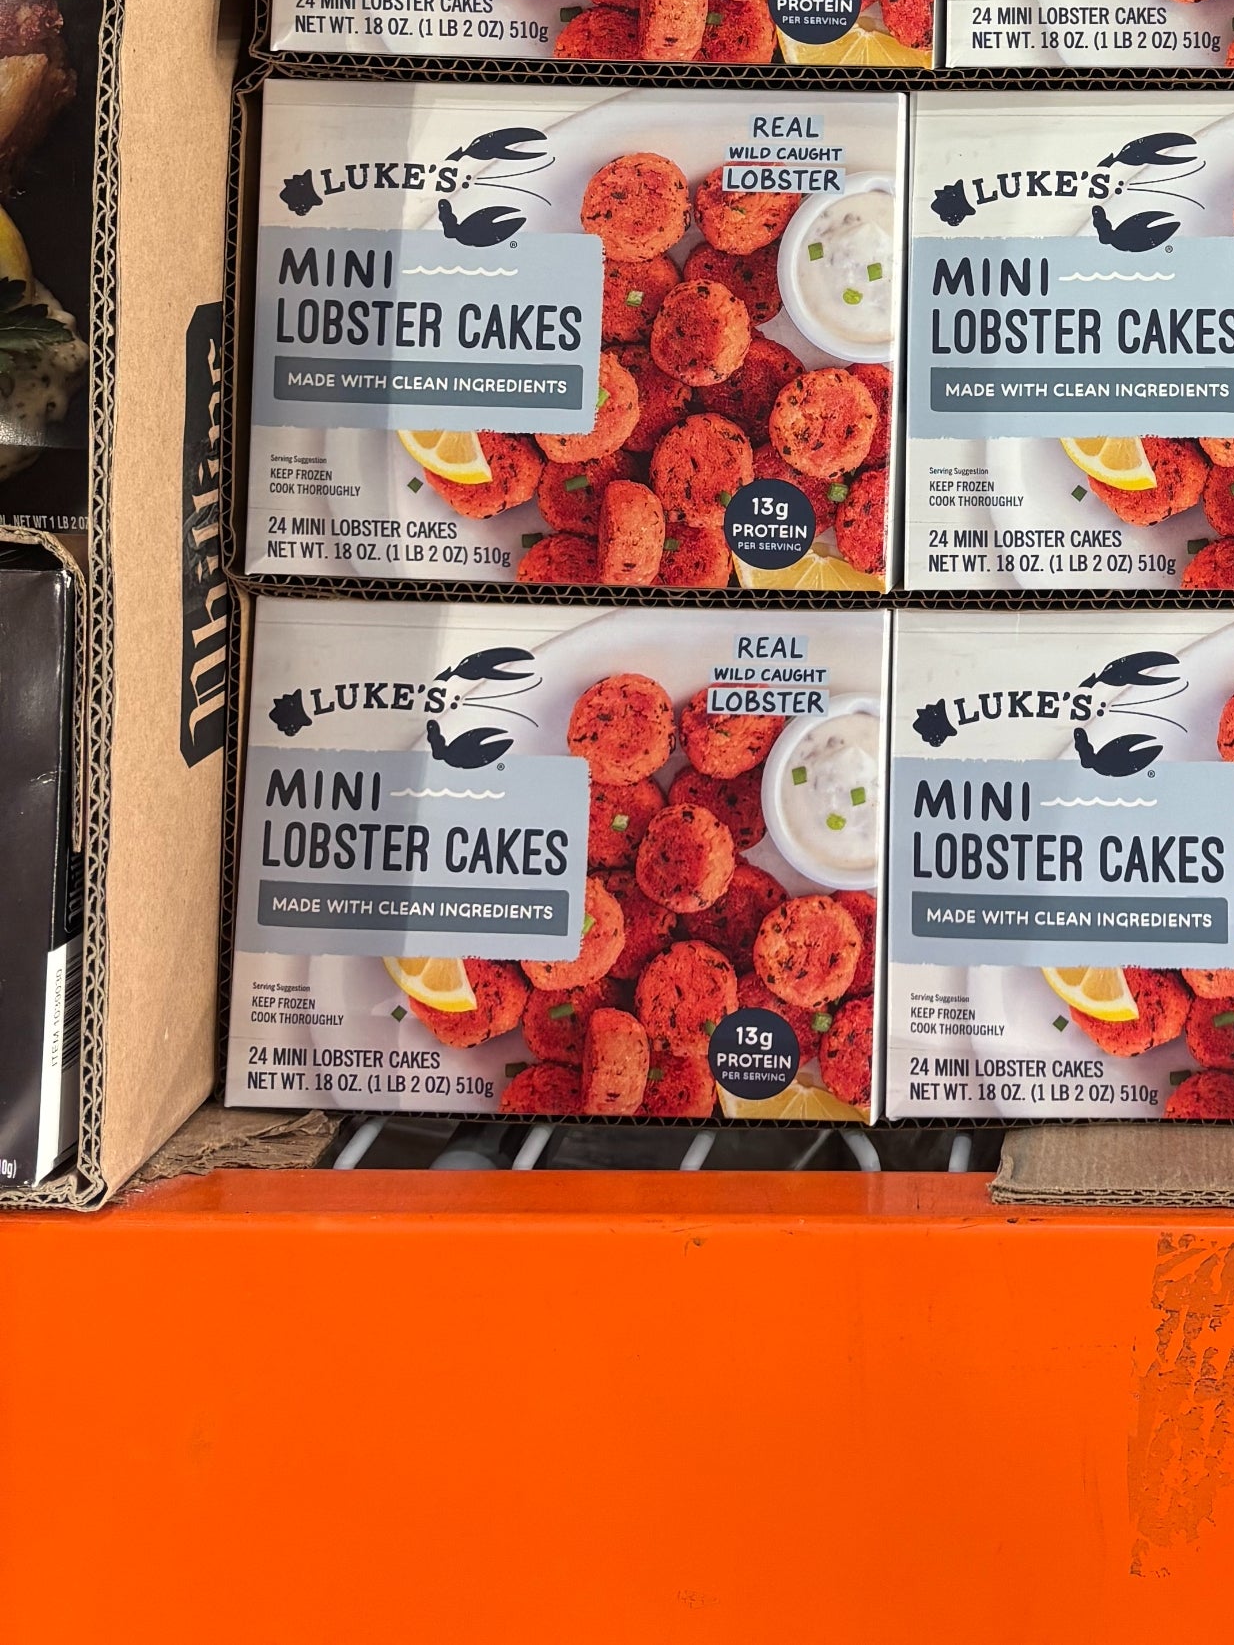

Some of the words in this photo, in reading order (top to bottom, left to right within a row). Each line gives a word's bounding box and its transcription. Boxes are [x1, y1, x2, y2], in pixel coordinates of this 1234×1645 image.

[972, 32, 1001, 49] NET
[1006, 32, 1034, 49] WT.
[1041, 32, 1059, 49] 18
[1064, 32, 1088, 49] OZ.
[1094, 31, 1107, 50] (1
[1114, 32, 1133, 49] LB
[1138, 32, 1147, 49] 2
[1152, 31, 1178, 50] OZ)
[1183, 32, 1220, 51] 510g
[277, 246, 393, 289] MINI
[932, 257, 1048, 297] MINI
[274, 299, 444, 348] LOBSTER
[458, 303, 582, 351] CAKES
[932, 309, 1102, 354] LOBSTER
[33, 516, 48, 529] WT
[50, 516, 55, 529] 1
[57, 516, 69, 529] LB
[71, 517, 77, 530] 2
[752, 497, 789, 521] 13g
[732, 524, 807, 539] PROTEIN
[737, 542, 756, 550] PER
[758, 542, 802, 551] SERVING
[264, 768, 382, 812] MINI
[913, 779, 1030, 821] MINI
[260, 821, 431, 871] LOBSTER
[445, 827, 570, 876] CAKES
[912, 834, 1083, 881] LOBSTER
[1100, 836, 1225, 883] CAKES
[250, 1011, 277, 1023] COOK
[279, 1012, 344, 1025] THOROUGHLY
[251, 996, 276, 1007] KEEP
[277, 998, 316, 1009] FROZEN
